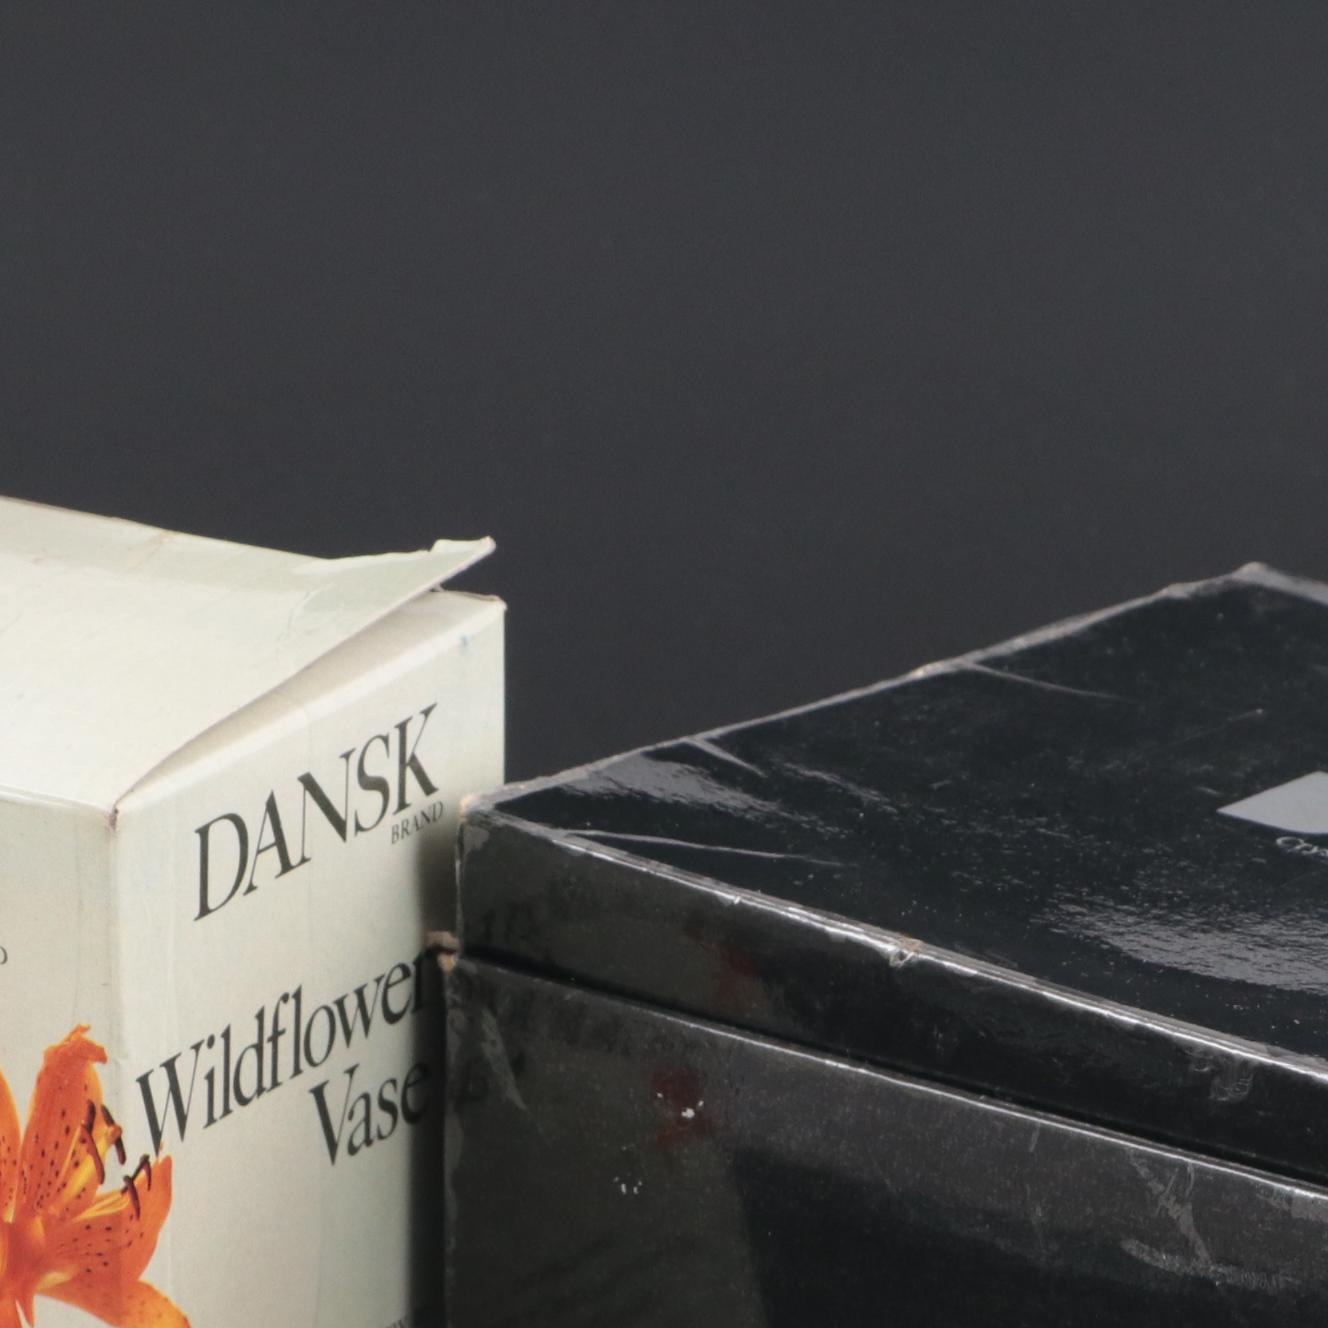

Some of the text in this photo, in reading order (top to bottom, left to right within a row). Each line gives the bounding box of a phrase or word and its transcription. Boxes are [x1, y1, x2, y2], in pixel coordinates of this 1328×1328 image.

[193, 701, 441, 922] DANSK
[390, 799, 445, 846] BRAND
[134, 950, 432, 1158] Wildflower
[308, 1062, 430, 1167] Vase
